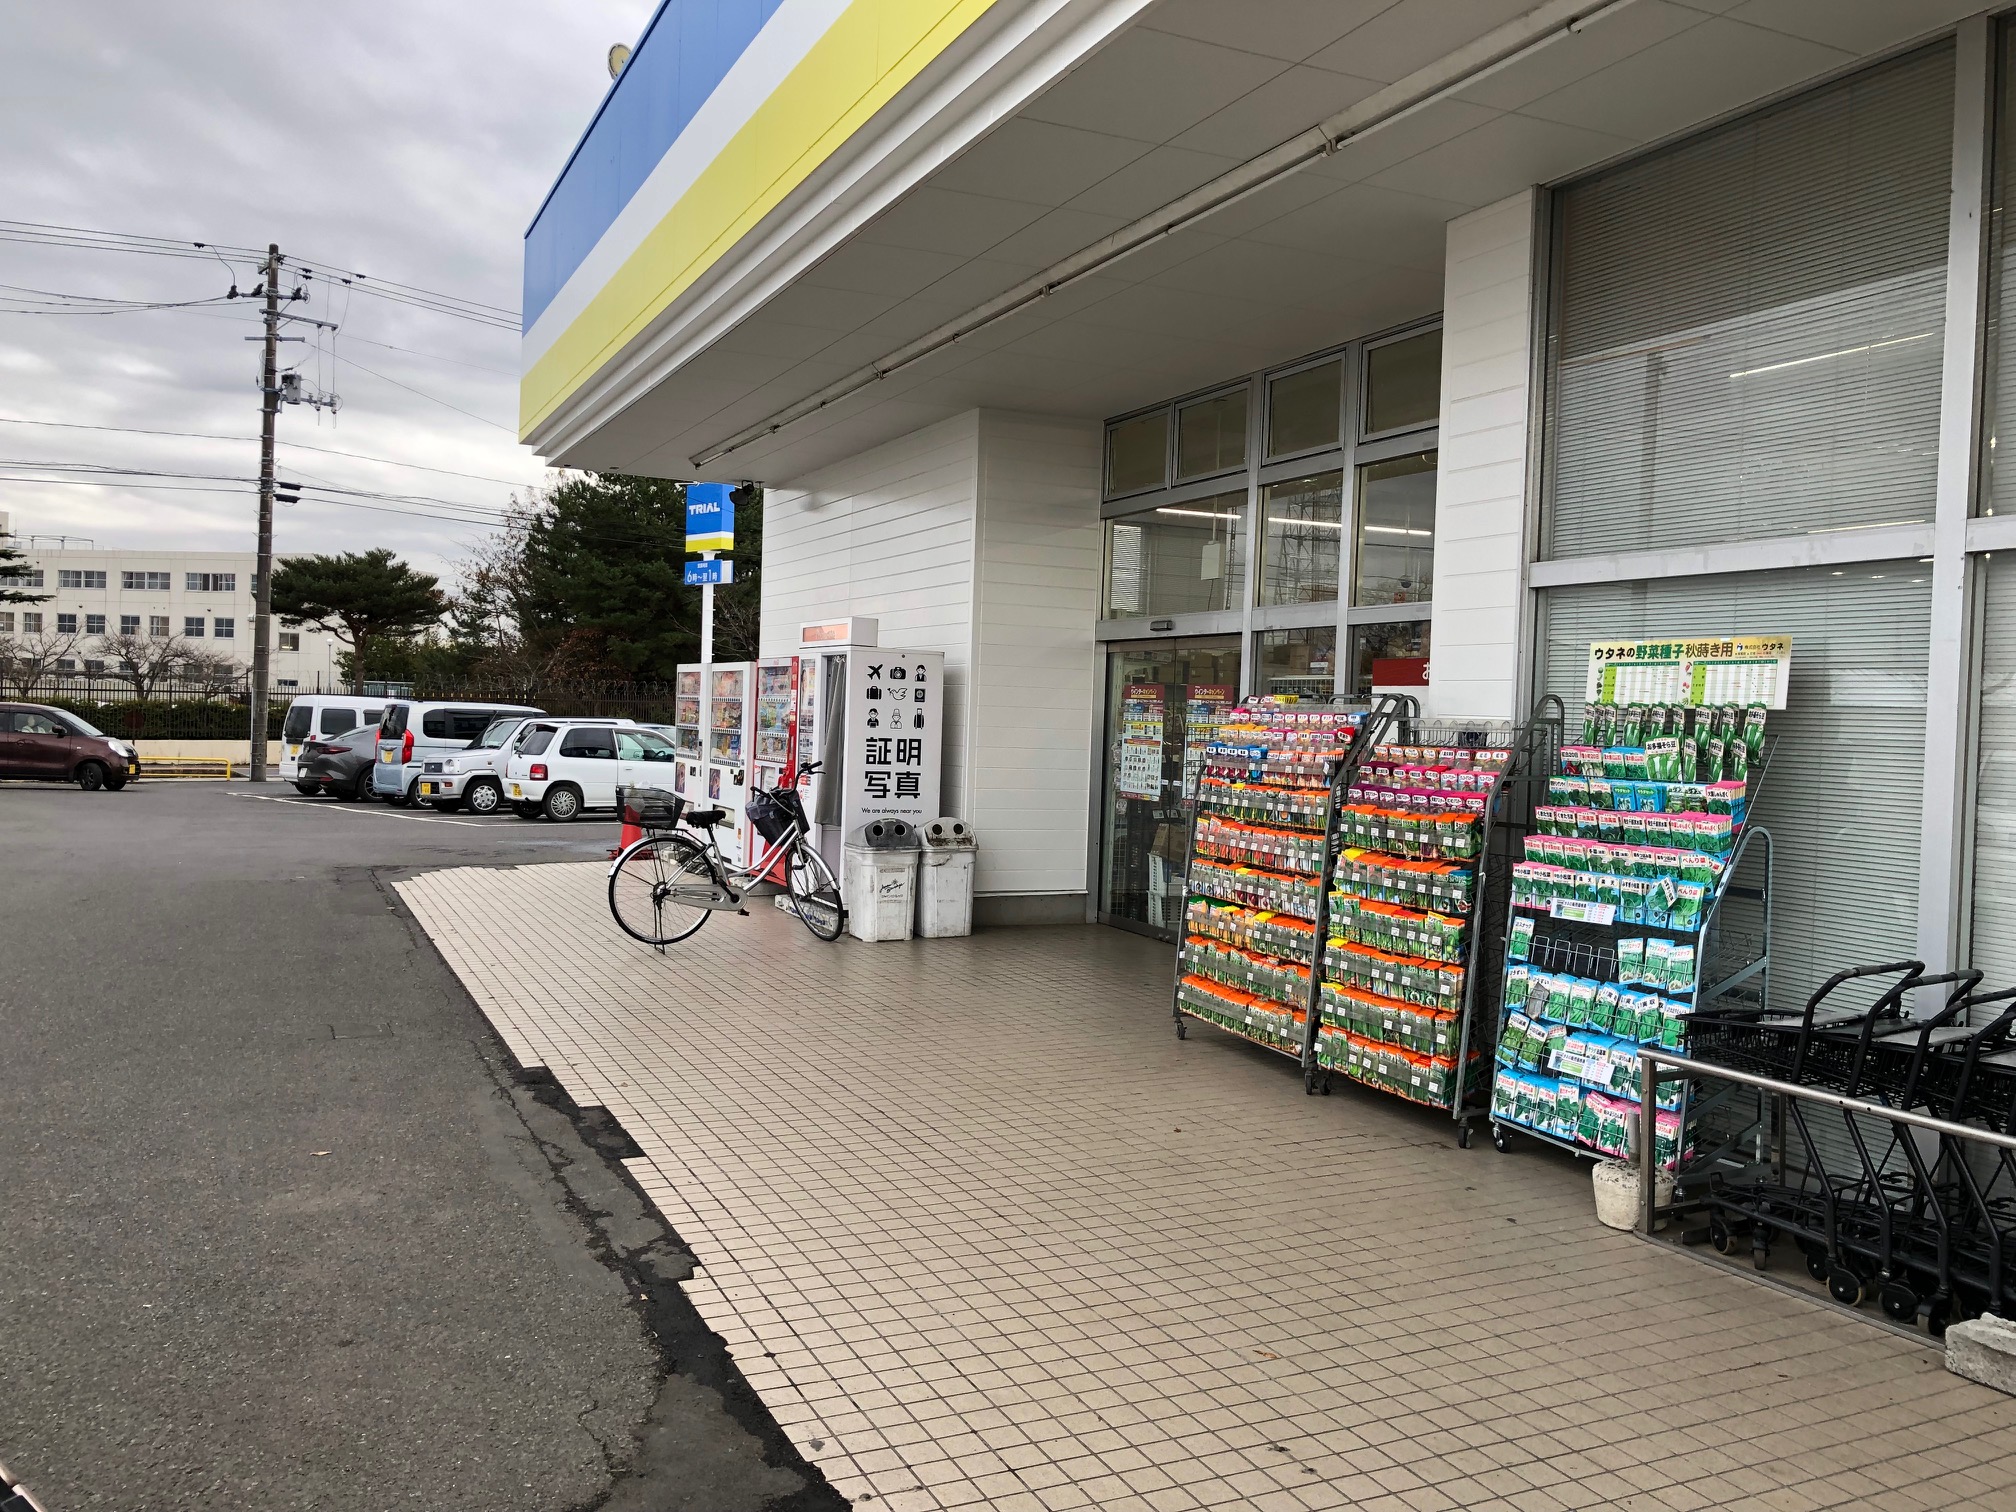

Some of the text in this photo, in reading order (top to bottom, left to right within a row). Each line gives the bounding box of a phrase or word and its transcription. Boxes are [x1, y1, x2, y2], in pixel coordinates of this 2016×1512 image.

[689, 502, 720, 515] TRIAL
[865, 736, 922, 766] 証明
[864, 770, 922, 799] 写真
[881, 807, 899, 815] always
